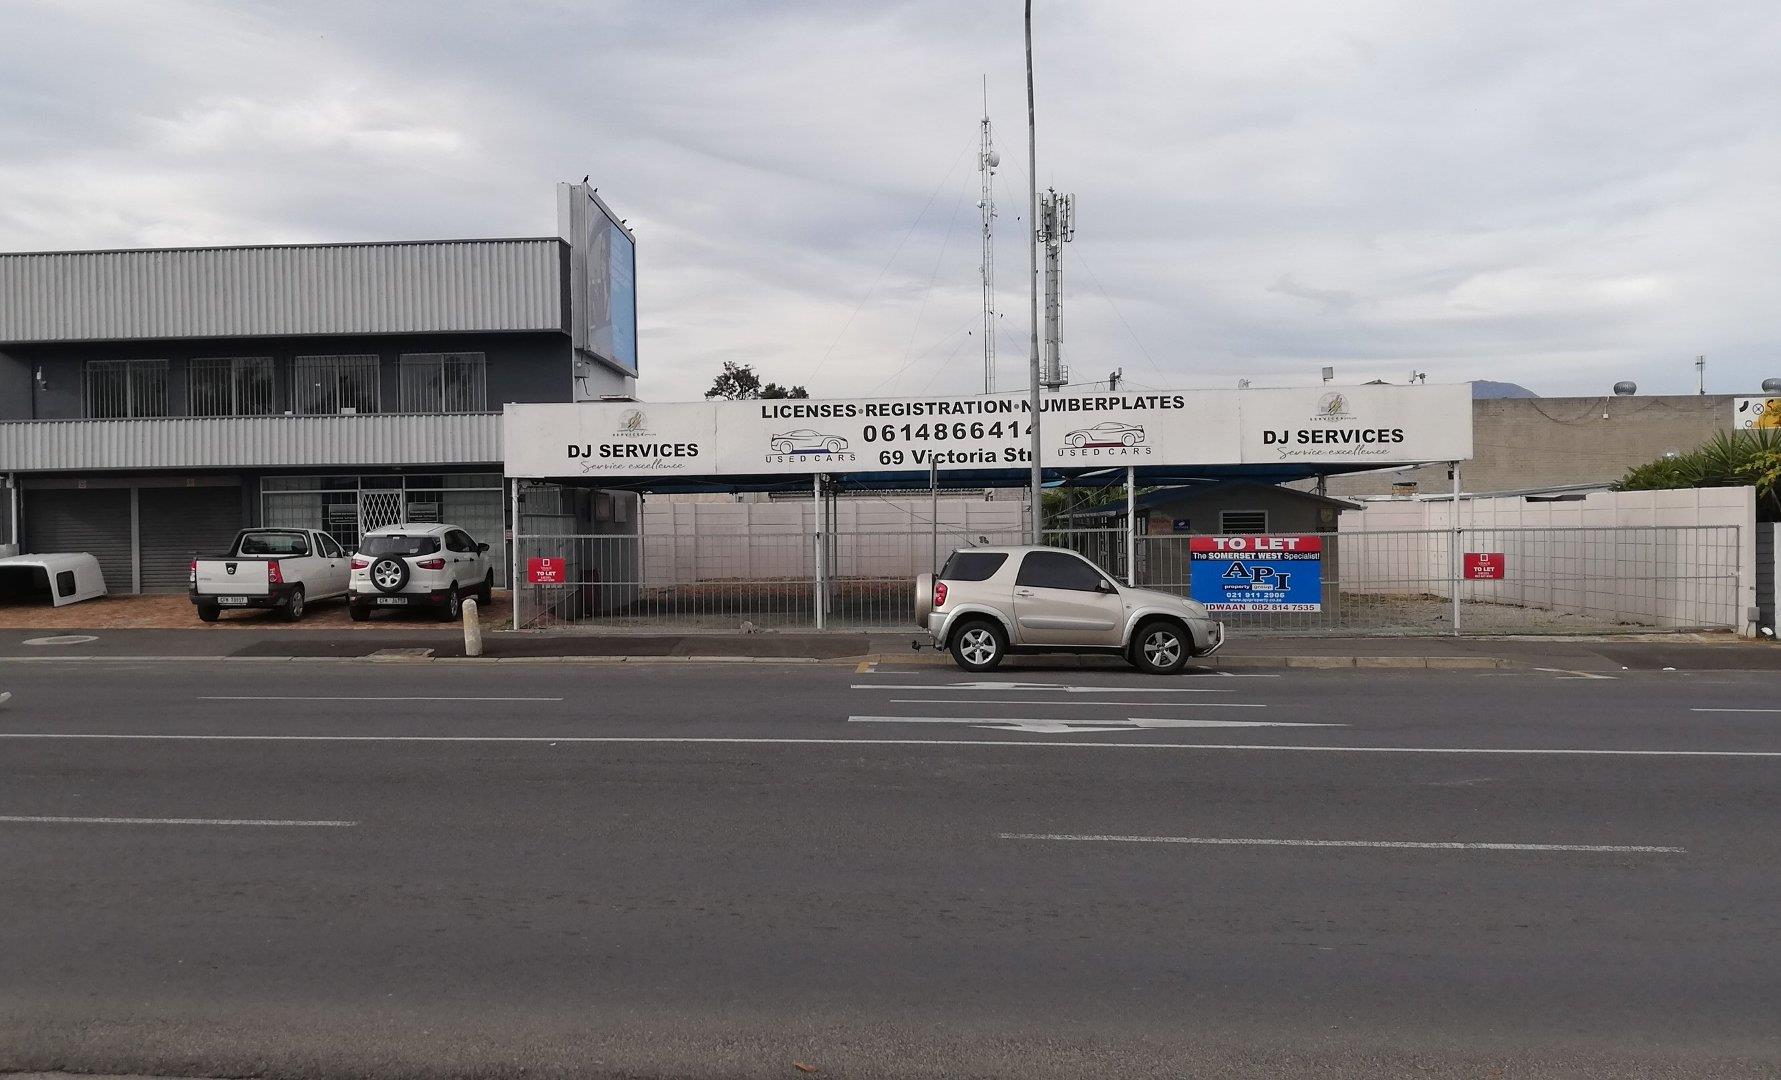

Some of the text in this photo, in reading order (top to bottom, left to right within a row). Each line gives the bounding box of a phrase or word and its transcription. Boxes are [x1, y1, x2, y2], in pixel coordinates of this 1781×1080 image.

[762, 404, 857, 418] LICENSES
[865, 400, 1012, 417] REGISTRATION
[1263, 428, 1404, 445] DJ SERVICES
[567, 443, 699, 458] DJ SERVICES
[879, 449, 904, 465] 69
[911, 447, 997, 465] Victoria
[1058, 447, 1152, 456] USED CARS
[1277, 444, 1390, 459] Service excellence
[580, 459, 685, 473] Service excellence
[765, 454, 856, 463] USED CARS
[1213, 537, 1299, 550] TO LET
[1208, 552, 1255, 560] SOMERSET
[1258, 552, 1283, 560] WEST
[1284, 552, 1320, 561] Specialist!
[1222, 561, 1291, 590] API
